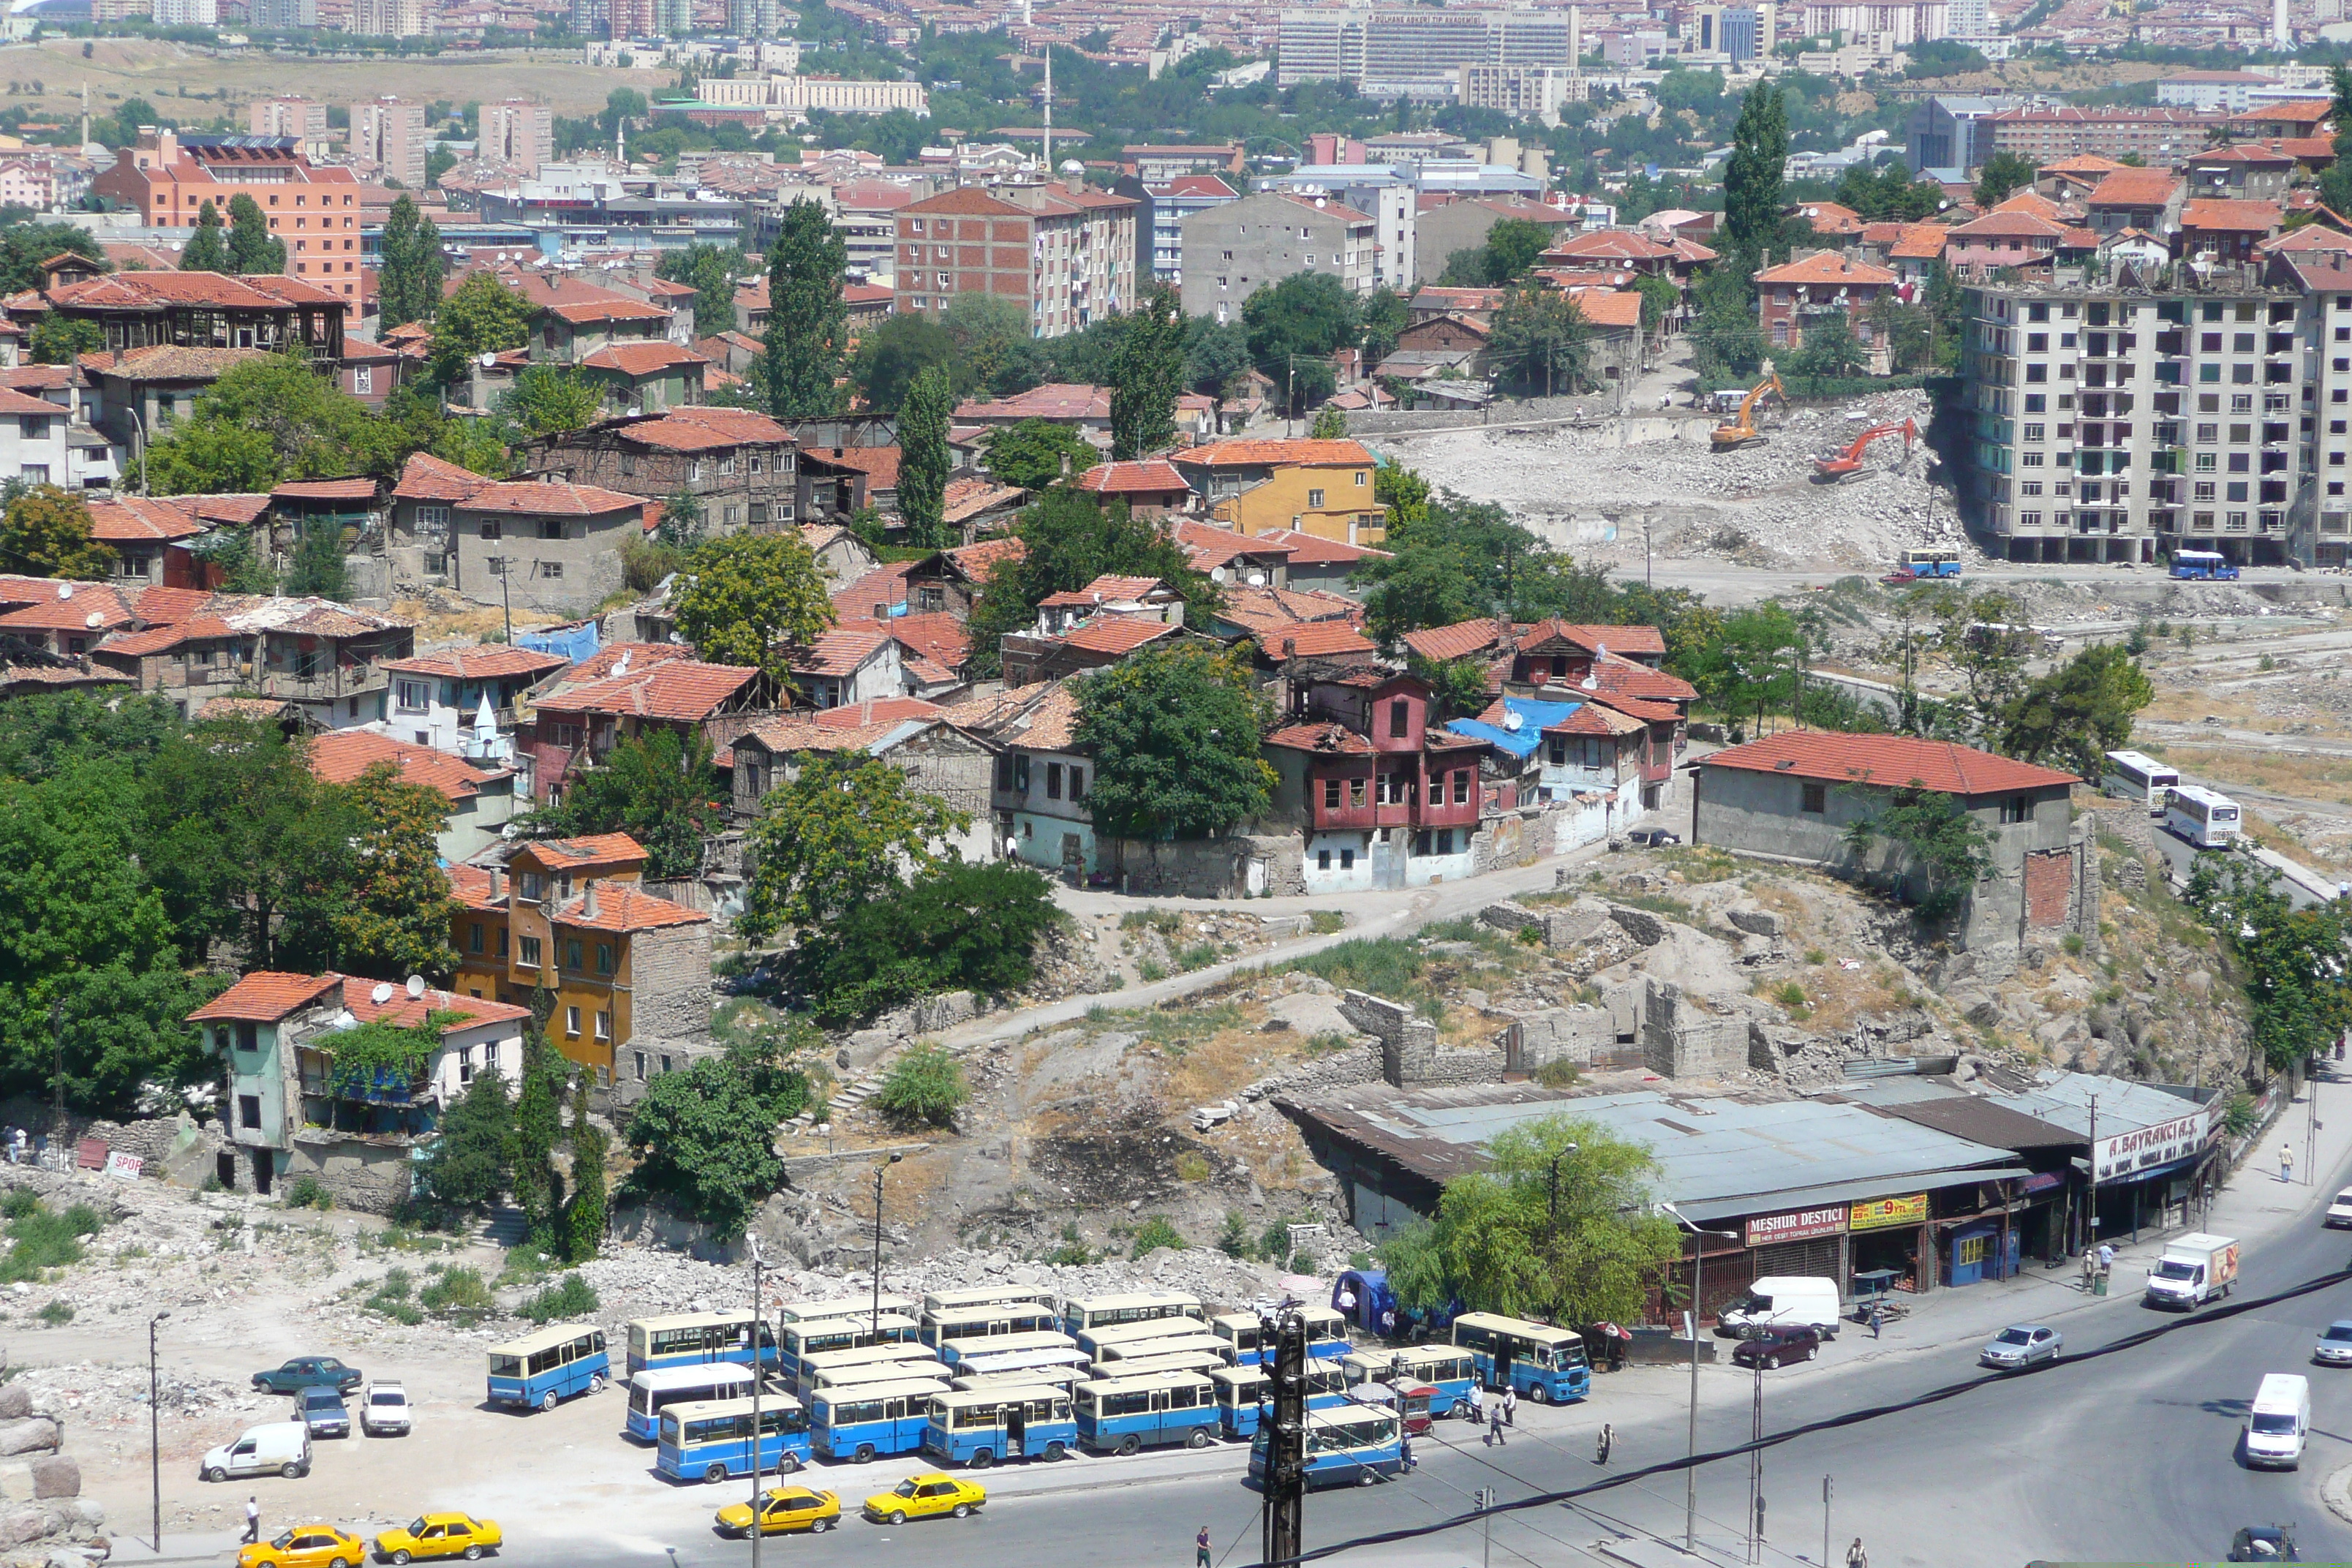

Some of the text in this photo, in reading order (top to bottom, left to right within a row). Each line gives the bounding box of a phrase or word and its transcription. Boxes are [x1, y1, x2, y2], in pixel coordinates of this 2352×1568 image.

[1375, 15, 1403, 23] GÜLHANE
[1884, 1201, 1893, 1215] 9
[1894, 1205, 1907, 1214] YTL
[1751, 1214, 1797, 1232] MEŞHUR
